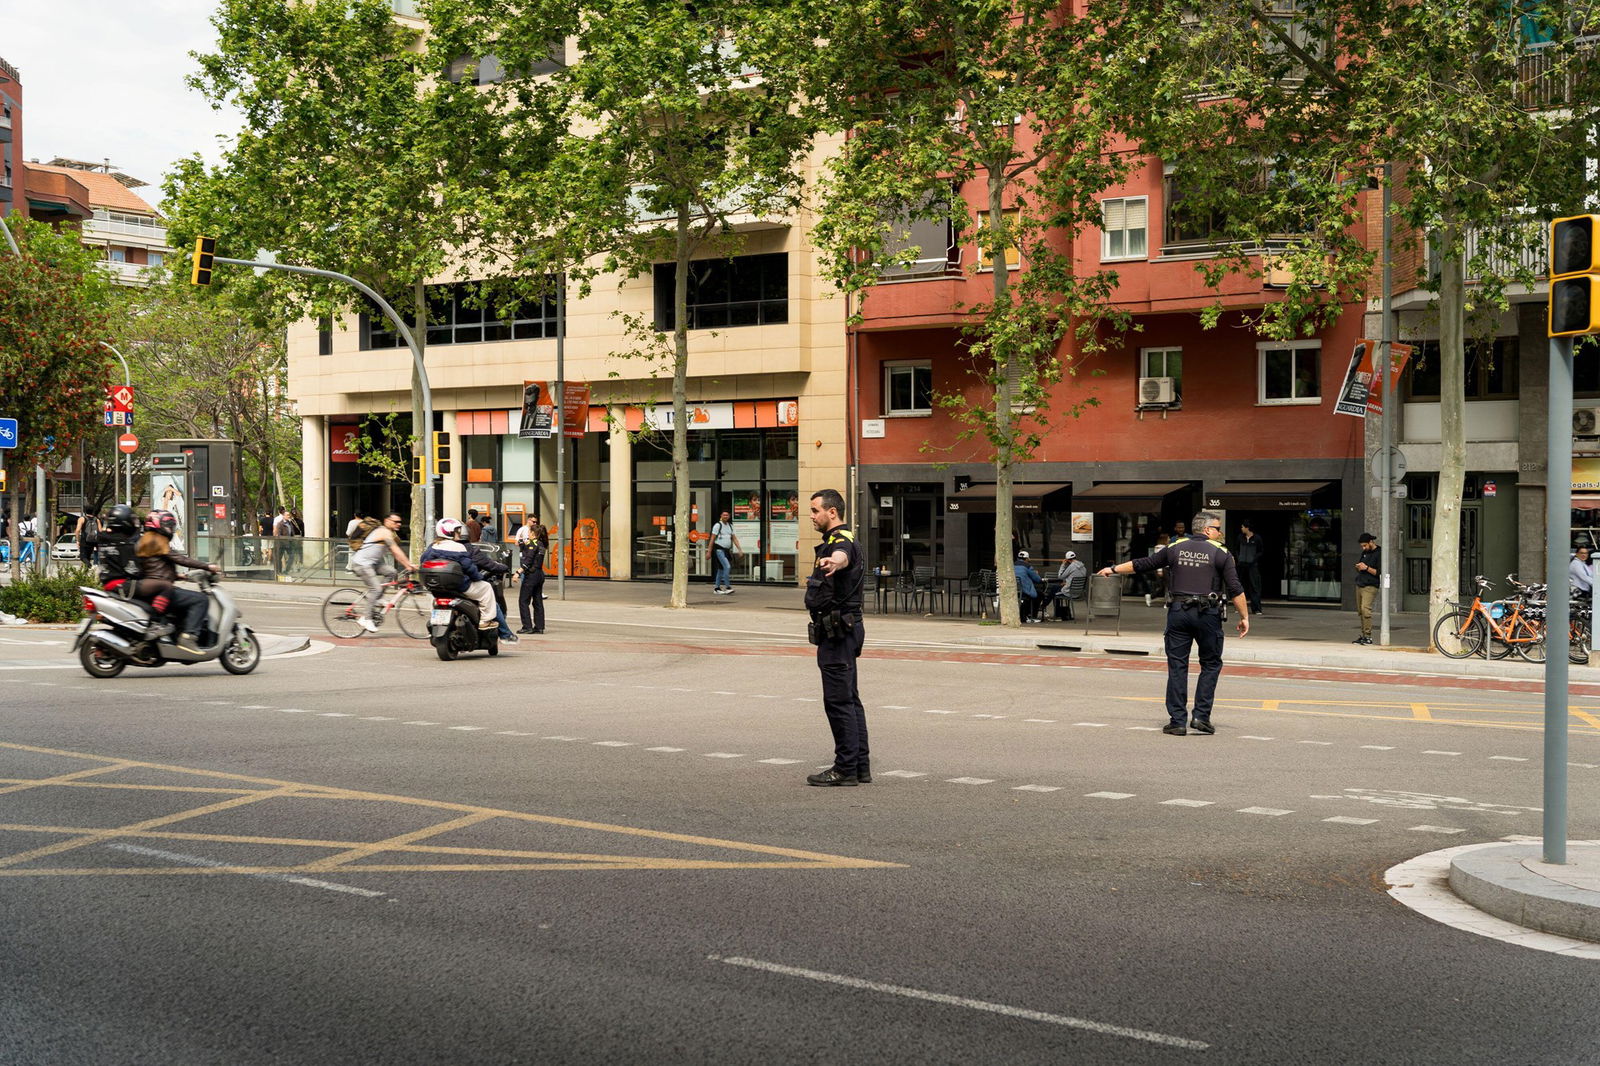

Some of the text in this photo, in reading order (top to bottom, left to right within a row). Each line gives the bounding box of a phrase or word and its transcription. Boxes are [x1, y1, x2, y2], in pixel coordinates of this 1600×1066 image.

[120, 392, 128, 401] M
[1521, 462, 1537, 471] 212
[1208, 499, 1221, 507] 365
[1179, 550, 1210, 561] POLICIA
